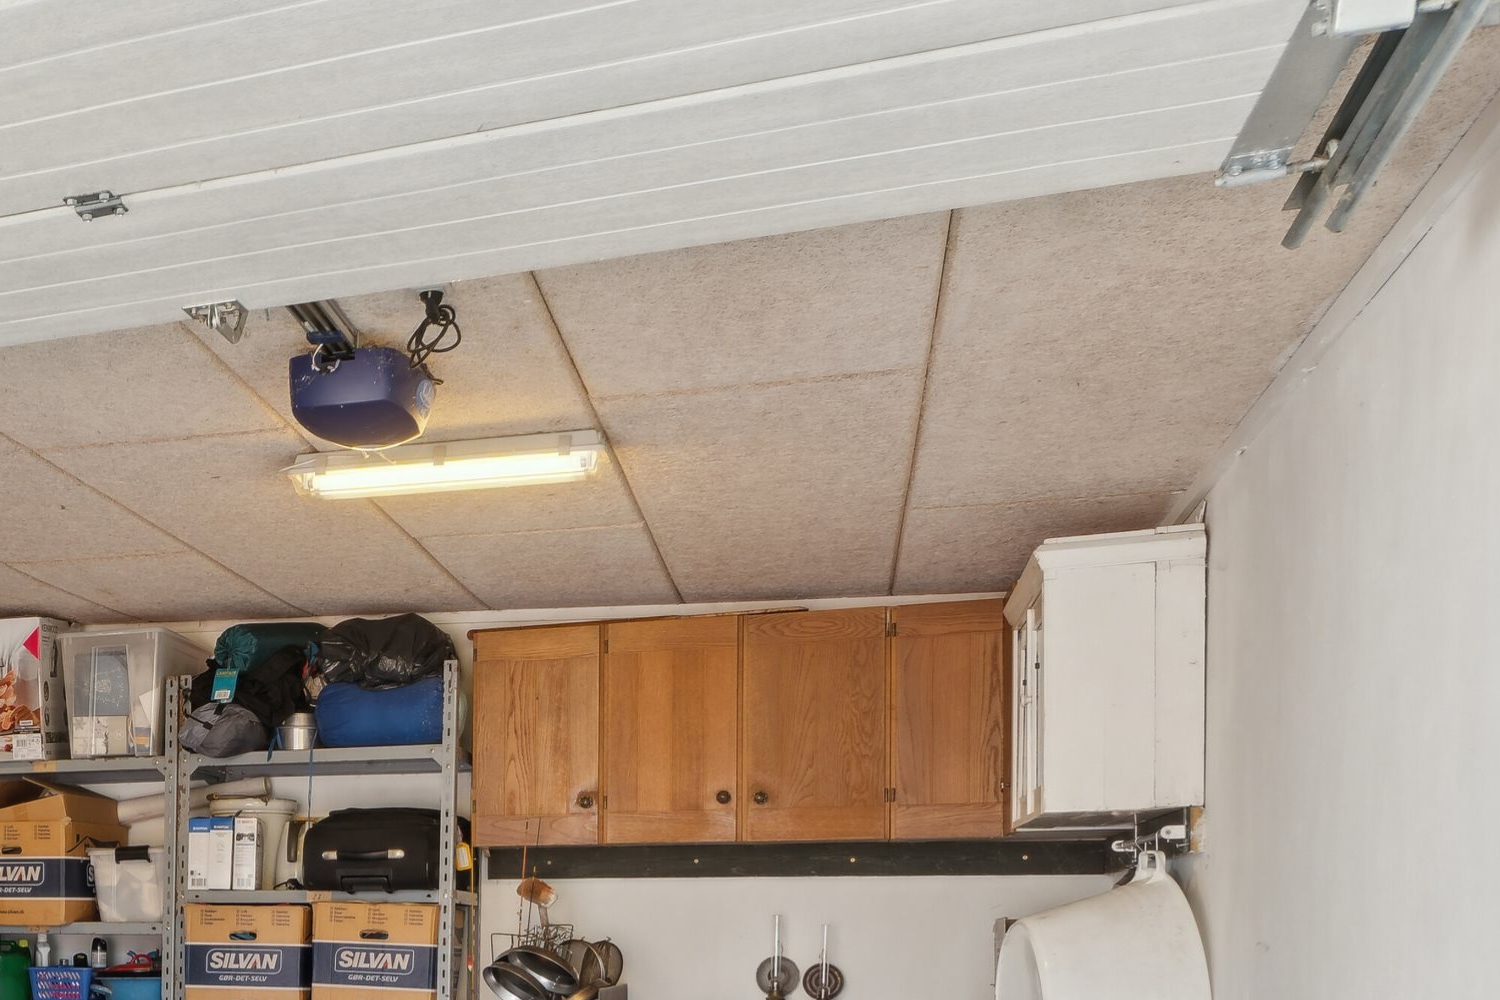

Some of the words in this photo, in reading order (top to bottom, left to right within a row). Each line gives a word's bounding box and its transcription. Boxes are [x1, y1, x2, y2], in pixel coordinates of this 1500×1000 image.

[209, 951, 277, 969] SILVAN
[338, 950, 410, 970] SILVAN
[348, 974, 399, 983] GØR-DET-SELV
